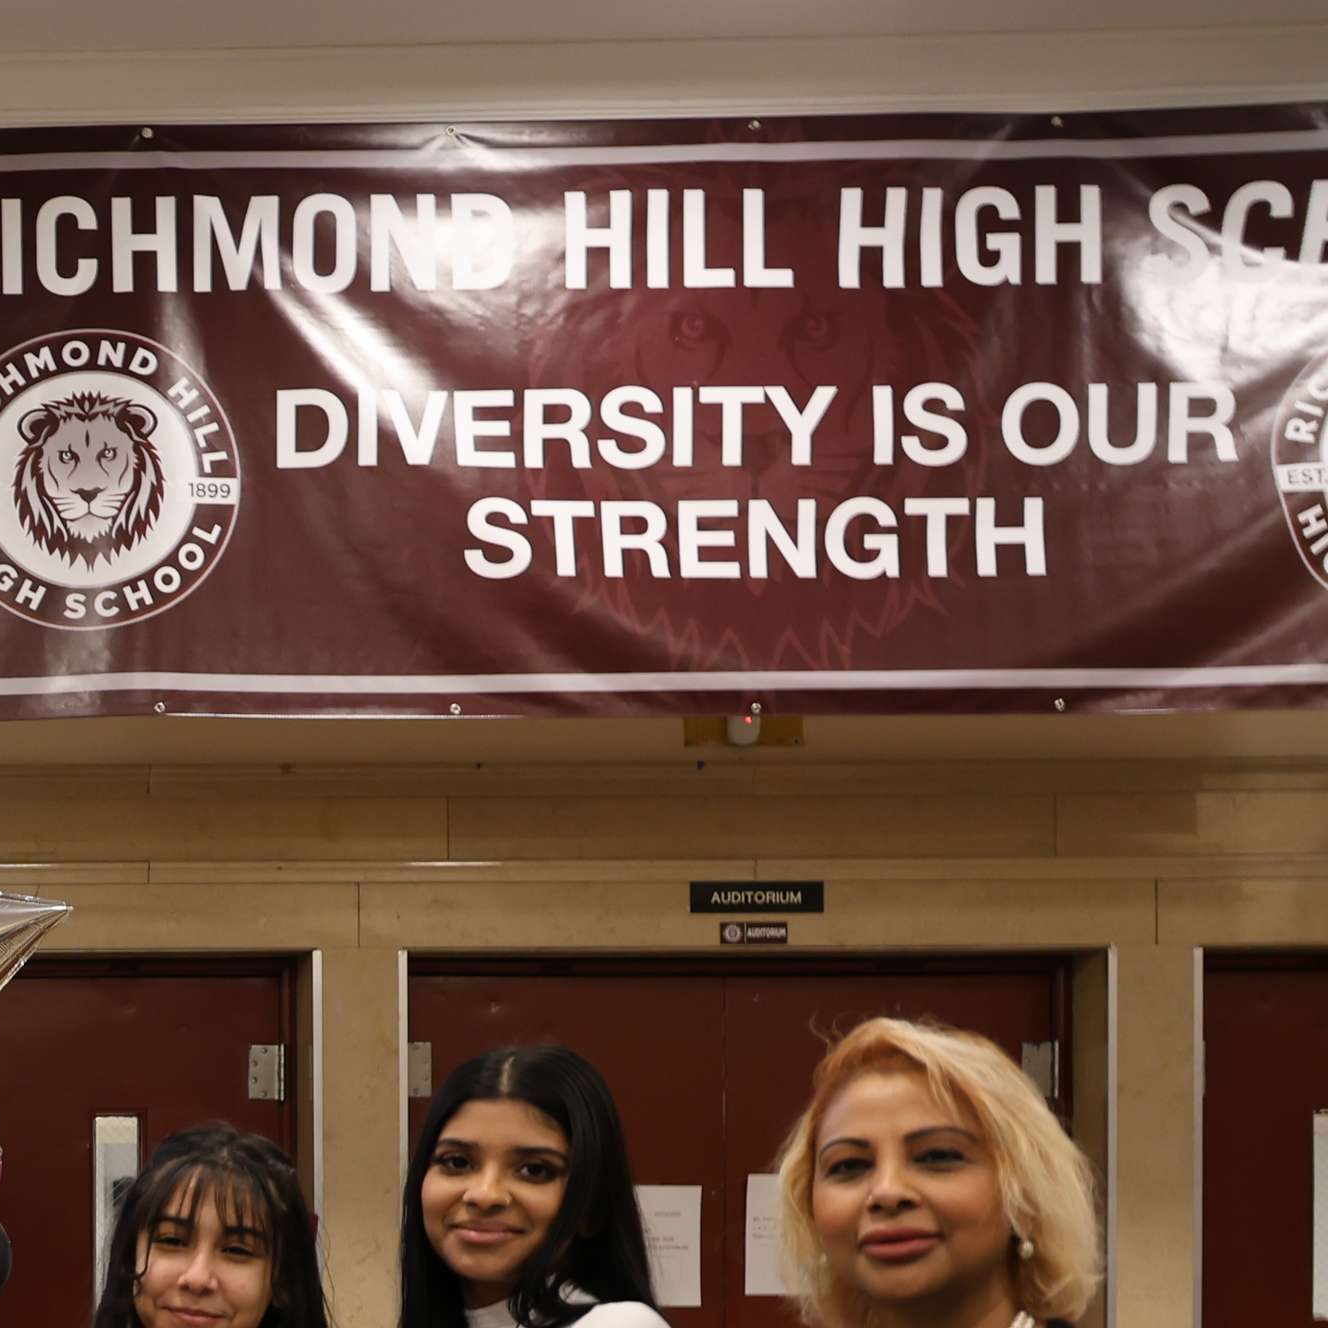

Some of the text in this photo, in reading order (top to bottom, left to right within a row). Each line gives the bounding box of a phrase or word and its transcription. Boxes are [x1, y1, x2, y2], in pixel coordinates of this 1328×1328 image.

[565, 188, 794, 289] HILL
[838, 184, 1102, 289] HIGH
[167, 377, 228, 474] HILL
[276, 381, 1239, 470] DIVERSITY IS OUR
[188, 482, 231, 498] 1899
[63, 523, 222, 619] SCHOOL
[463, 496, 1047, 580] STRENGTH
[711, 890, 802, 904] AUDITORIUM
